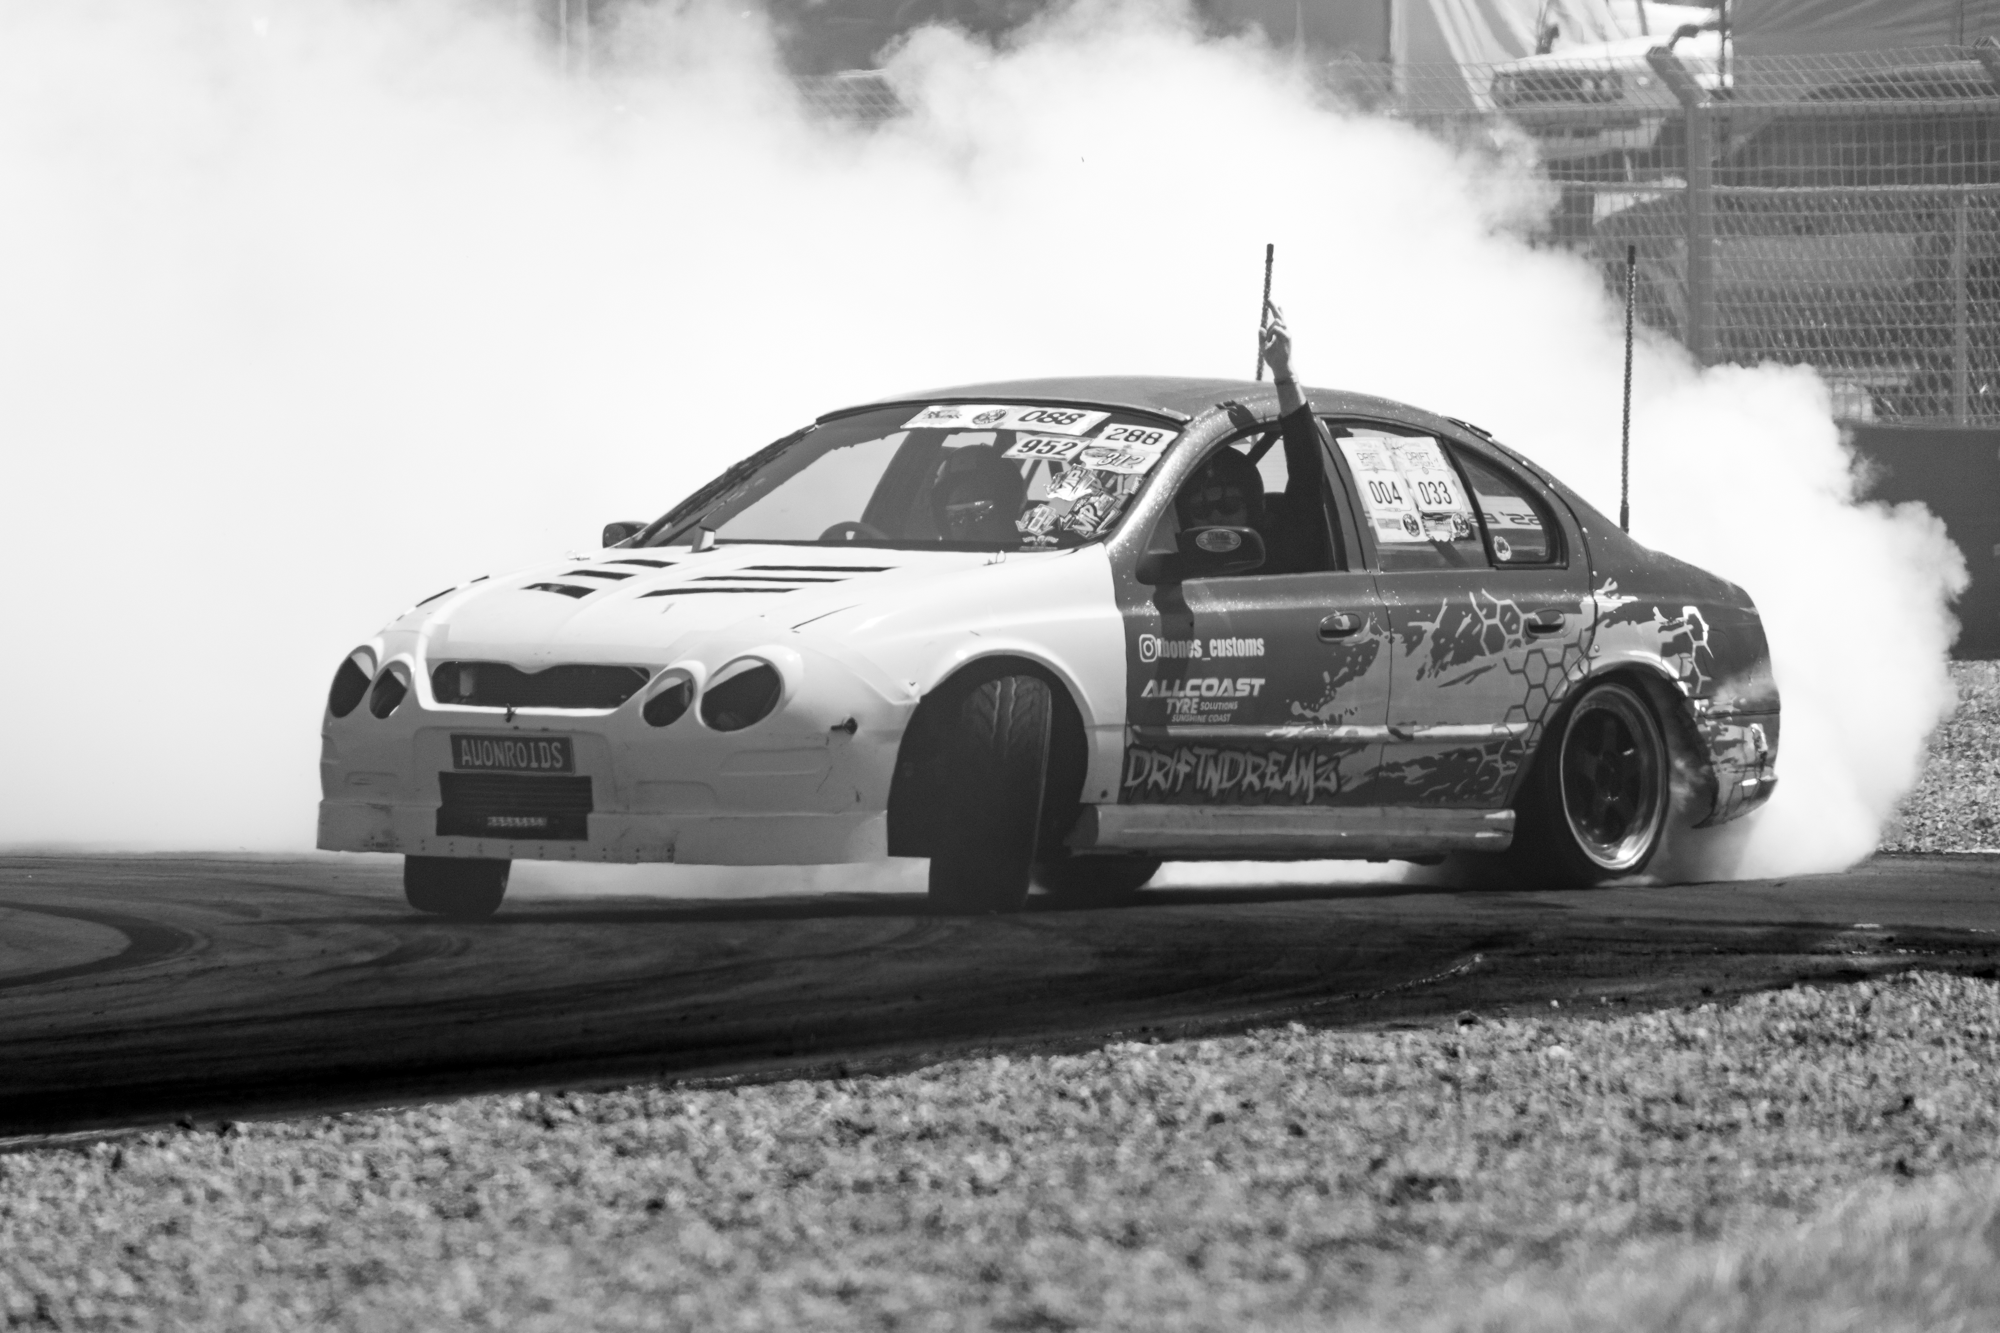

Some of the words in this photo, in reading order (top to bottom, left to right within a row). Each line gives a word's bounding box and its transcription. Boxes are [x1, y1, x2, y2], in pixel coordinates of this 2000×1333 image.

[1018, 409, 1084, 426] 088
[1104, 427, 1164, 446] 288
[1017, 438, 1078, 457] 952
[1368, 480, 1403, 504] 004
[1417, 481, 1453, 505] 033
[1141, 677, 1266, 698] ALLCOAST
[1166, 698, 1199, 715] TYRE
[1200, 701, 1239, 711] SOLUTIONS
[1171, 714, 1207, 723] SUNSHINE
[1208, 713, 1232, 723] COAST
